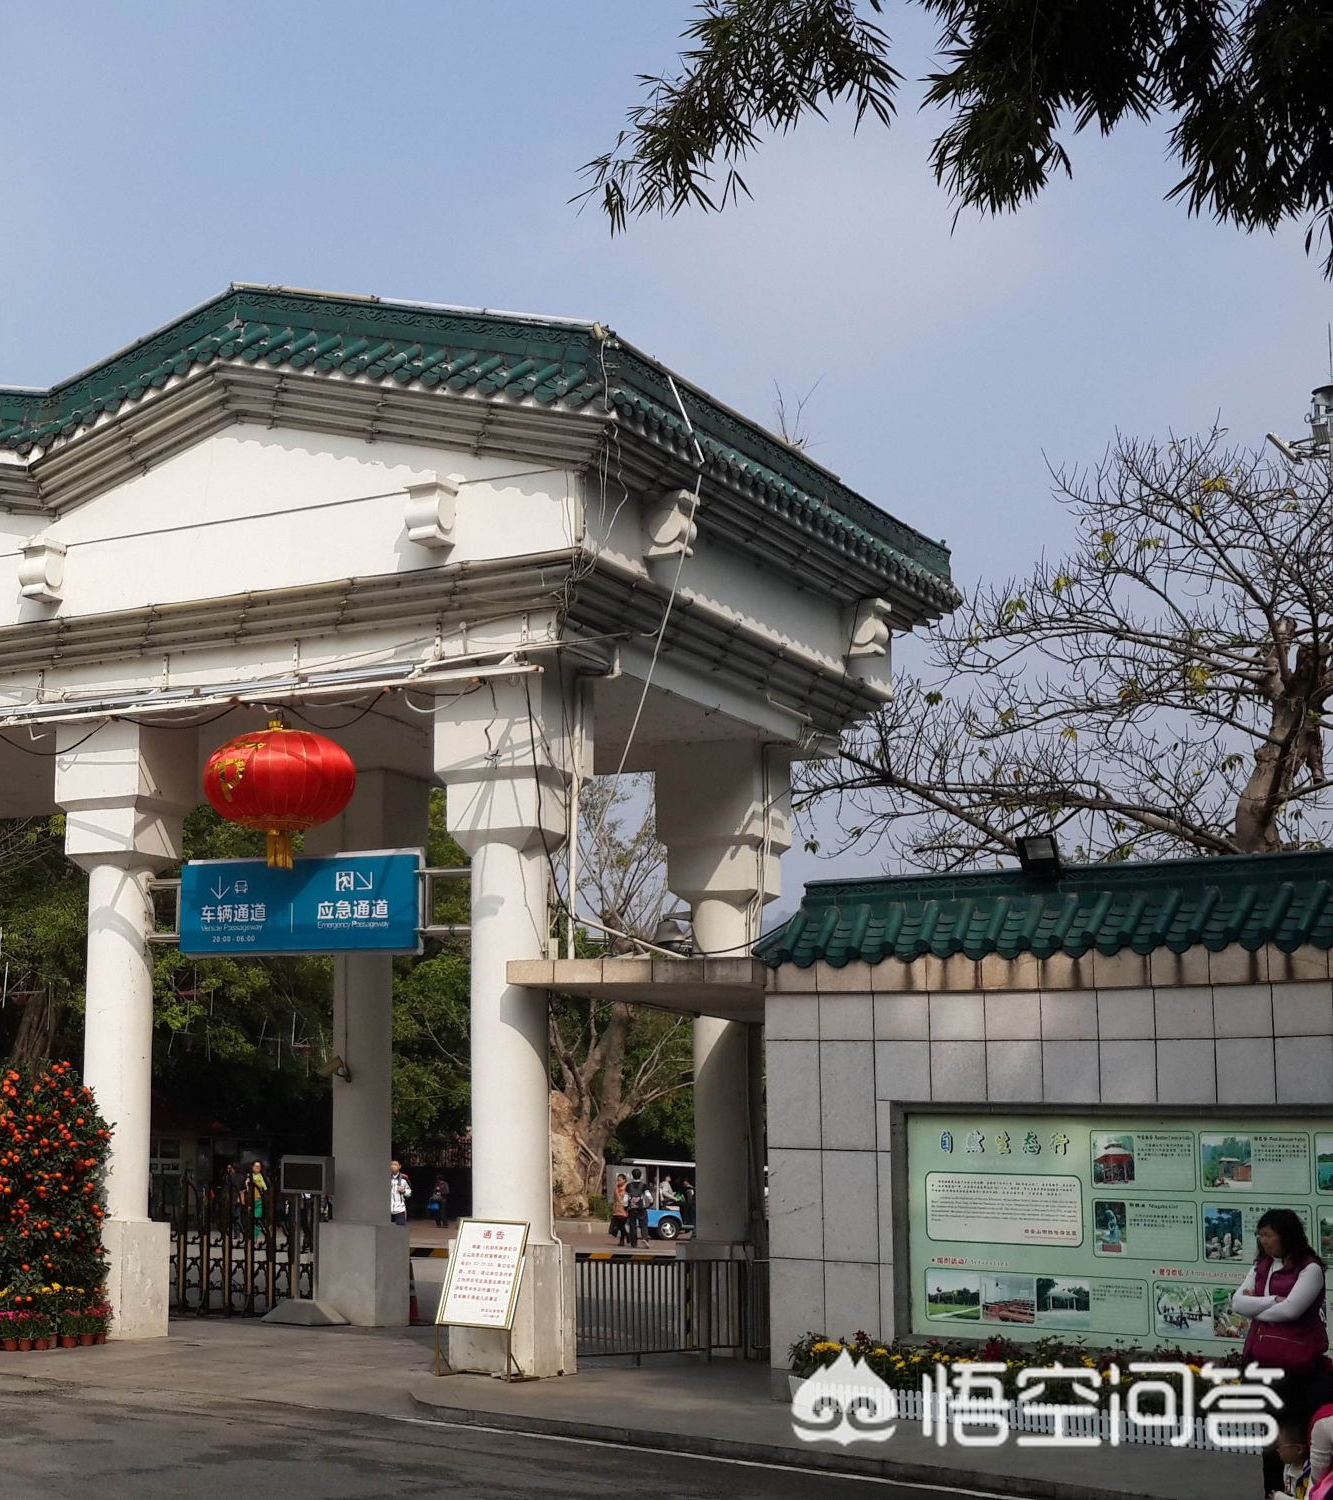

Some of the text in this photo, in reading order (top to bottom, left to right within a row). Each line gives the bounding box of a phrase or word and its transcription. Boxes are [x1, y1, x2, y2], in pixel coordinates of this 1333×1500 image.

[200, 903, 267, 923] 车辆通道
[317, 899, 389, 920] 应急通道
[201, 923, 263, 932] Vehicle Passageway
[317, 920, 389, 930] Emergency Passageway
[939, 1129, 1070, 1156] 自然生态行
[483, 1230, 505, 1240] 通告
